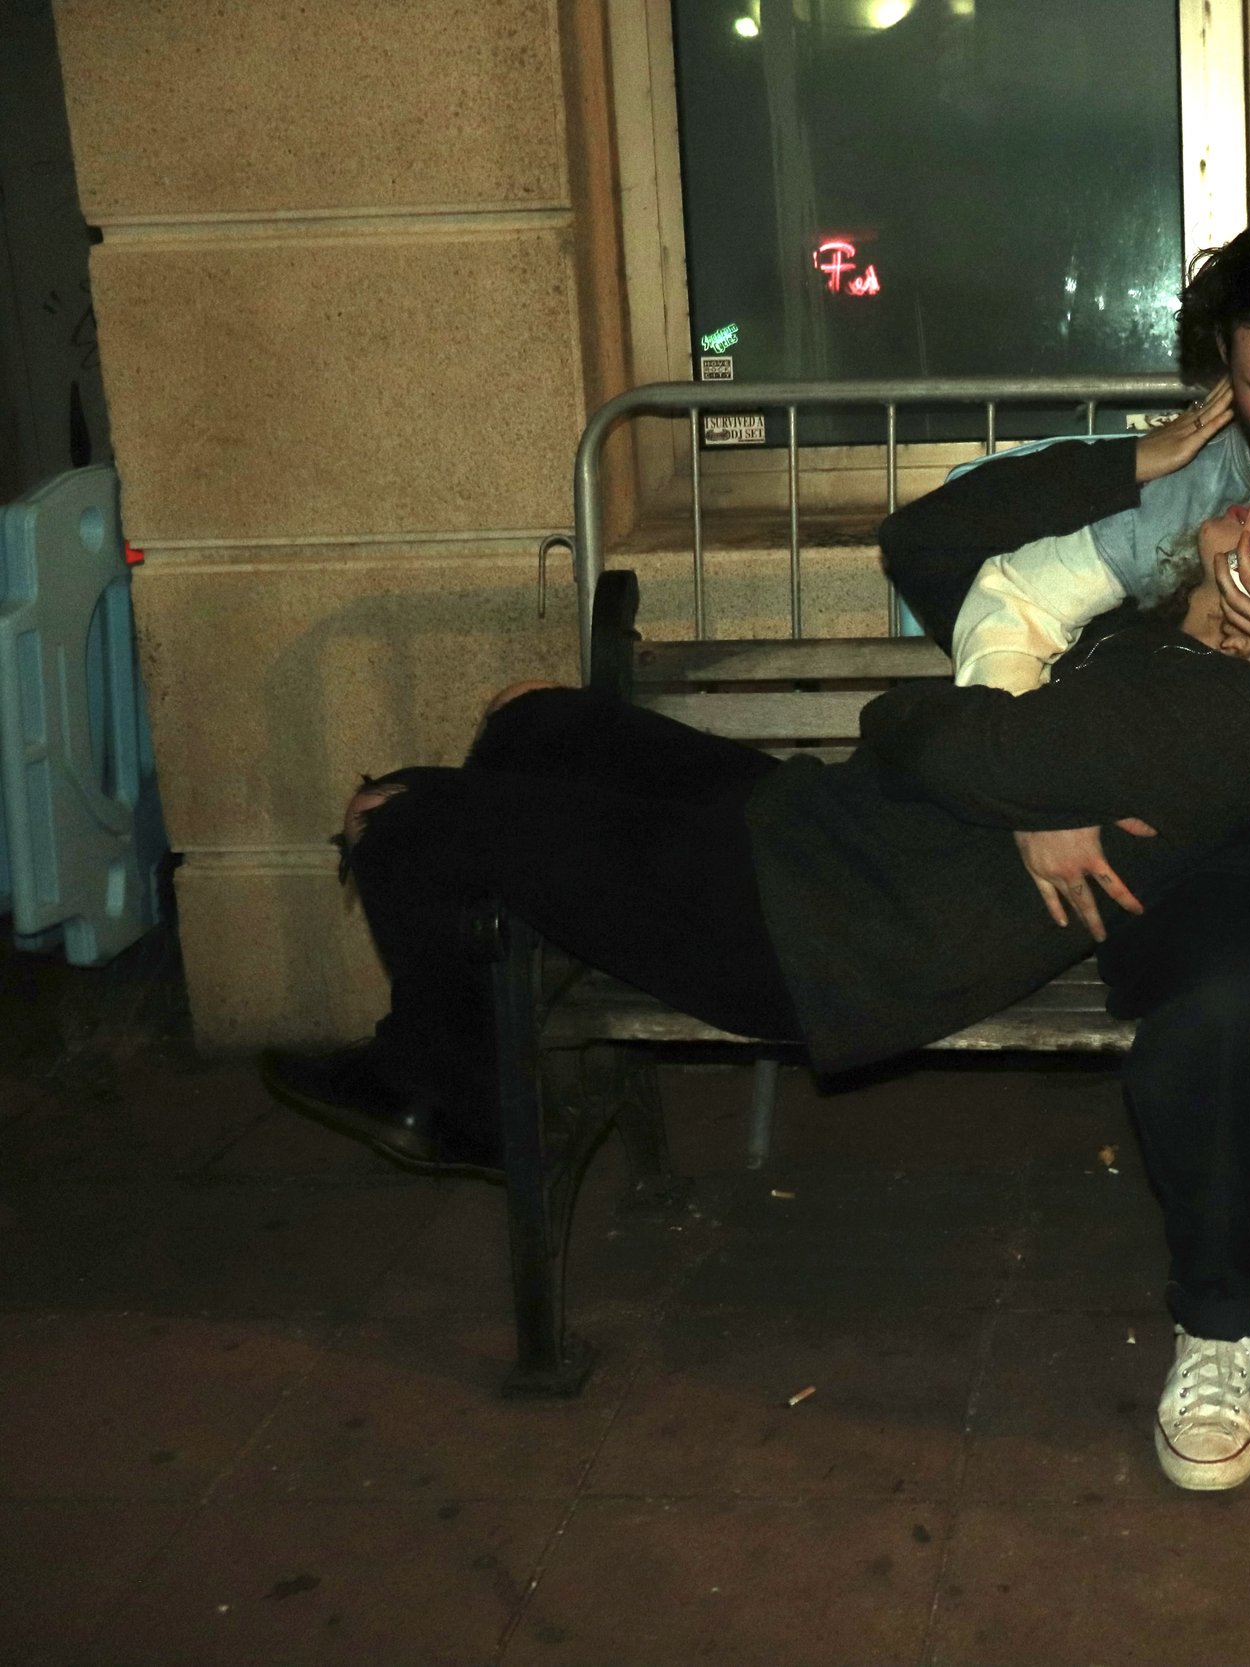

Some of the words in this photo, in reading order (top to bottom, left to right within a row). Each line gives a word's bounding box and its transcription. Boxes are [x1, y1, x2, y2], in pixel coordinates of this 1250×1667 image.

[711, 416, 756, 428] SURVIVED
[731, 429, 743, 439] DJ
[744, 429, 763, 439] SET
